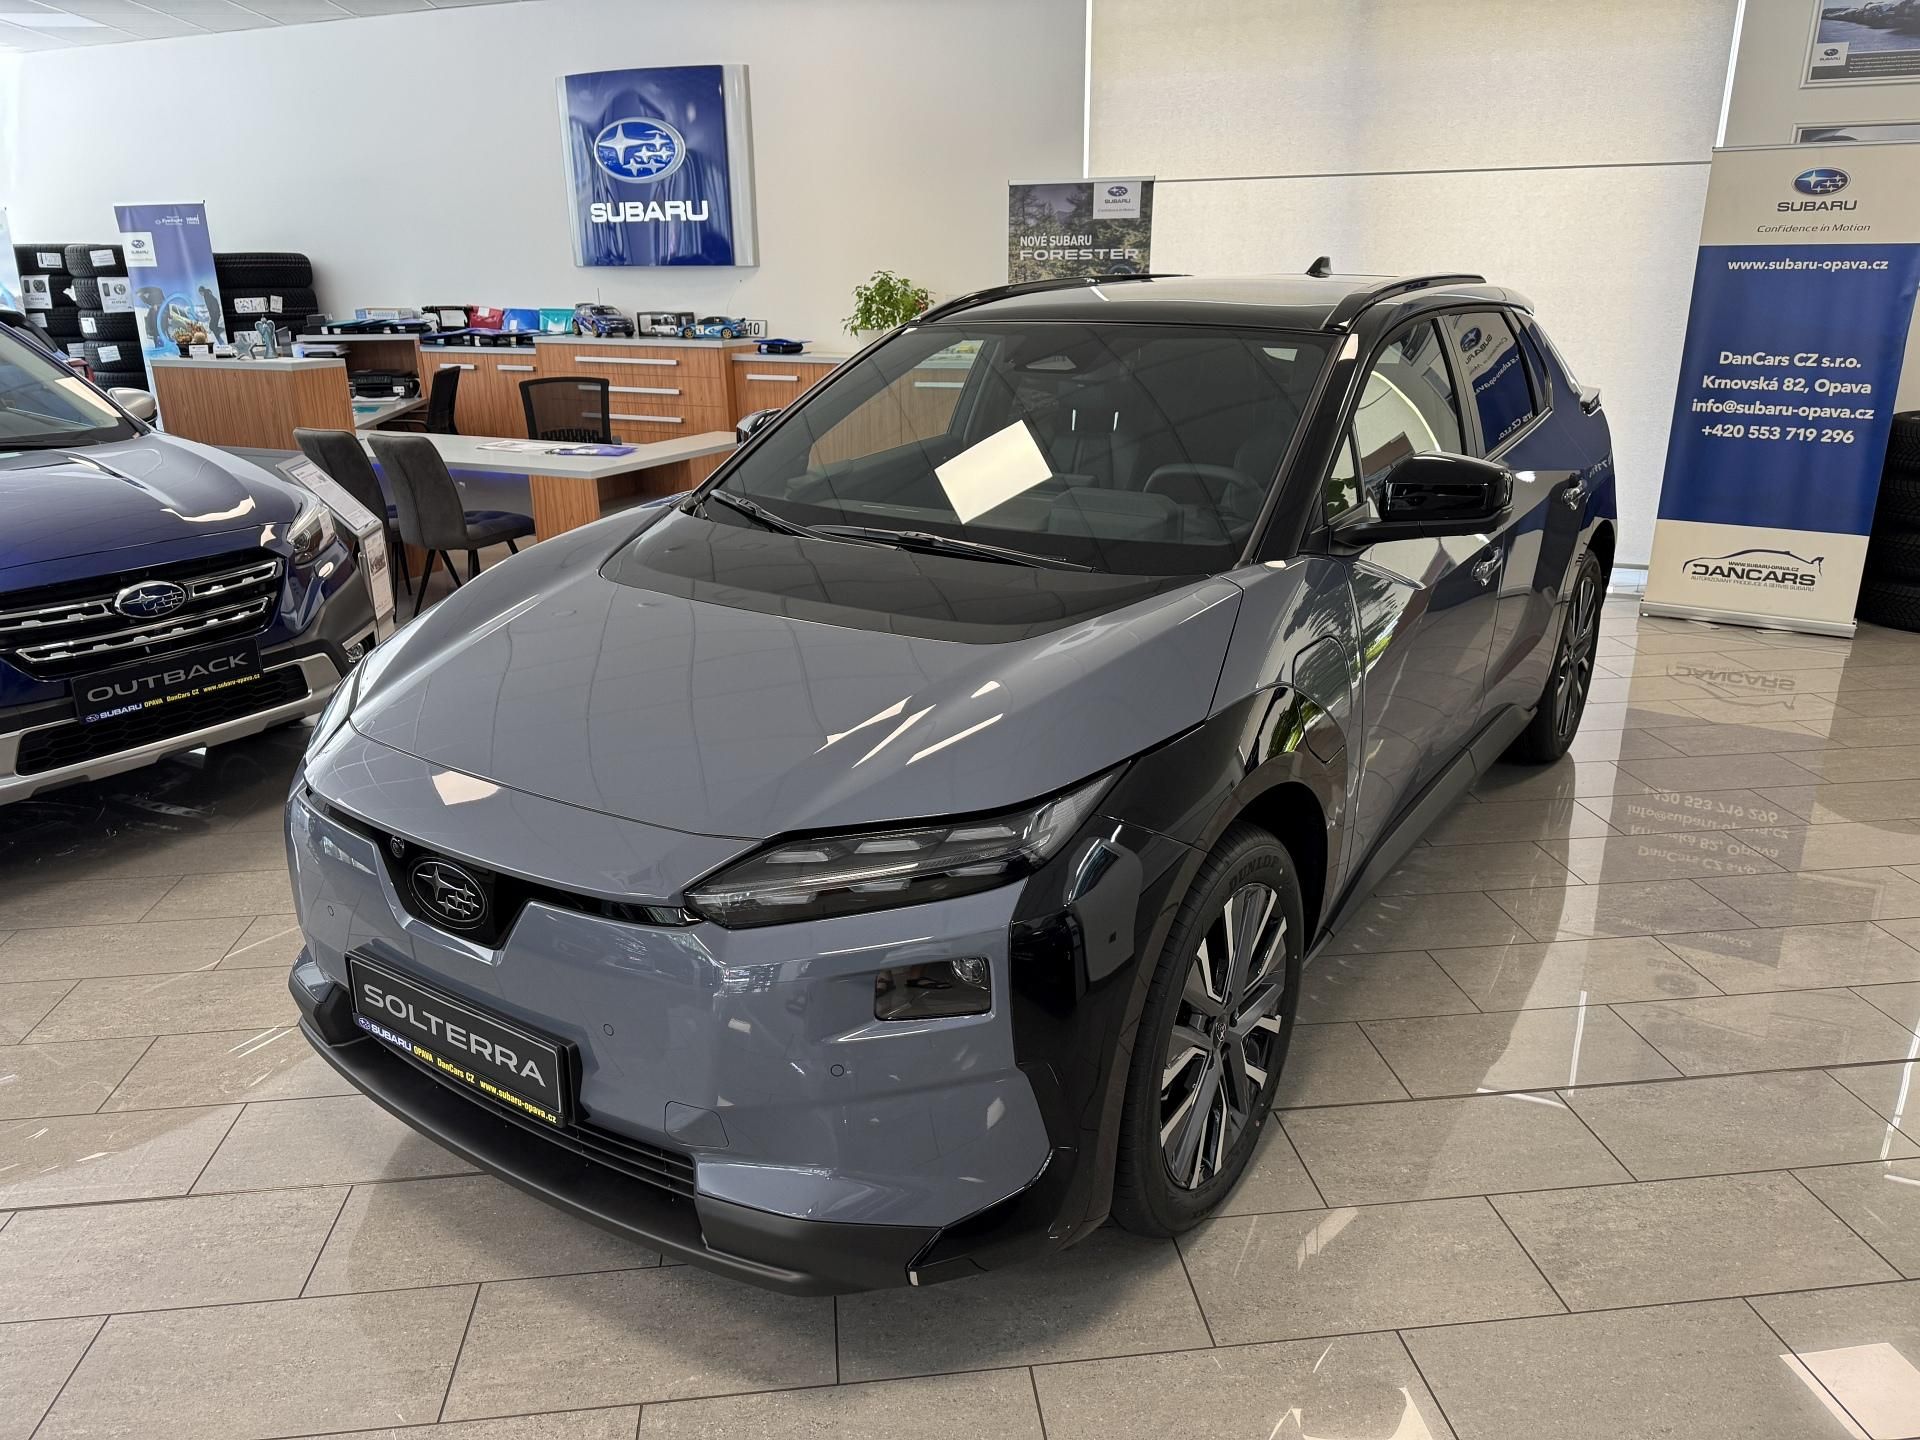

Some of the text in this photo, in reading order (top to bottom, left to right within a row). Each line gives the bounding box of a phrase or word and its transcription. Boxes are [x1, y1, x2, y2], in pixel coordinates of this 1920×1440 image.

[590, 200, 709, 223] SUBARU
[1777, 200, 1857, 212] SUBARU
[1757, 224, 1871, 233] Confidence in Motion
[1020, 232, 1092, 247] NOVÉ SUBARU
[1019, 248, 1139, 261] FORESTER
[1727, 258, 1889, 272] www.subaru-opava.cz
[1719, 351, 1862, 368] DanCars CZ s.r.o.
[1702, 375, 1872, 396] Krnovská 82, Opava
[1691, 398, 1875, 420] info@subaru-opava.cz
[1701, 424, 1855, 444] +420 553 719 296
[1691, 563, 1816, 587] DANCARS
[87, 652, 249, 702] OUTBACK
[99, 703, 142, 720] SUBARU
[144, 698, 164, 708] OPAVA
[1229, 854, 1280, 890] DUNLOP
[363, 983, 546, 1088] SOLTERRA
[371, 1023, 557, 1124] SUBARU OPAVA DanCars CZ www.subaru-opava.cz
